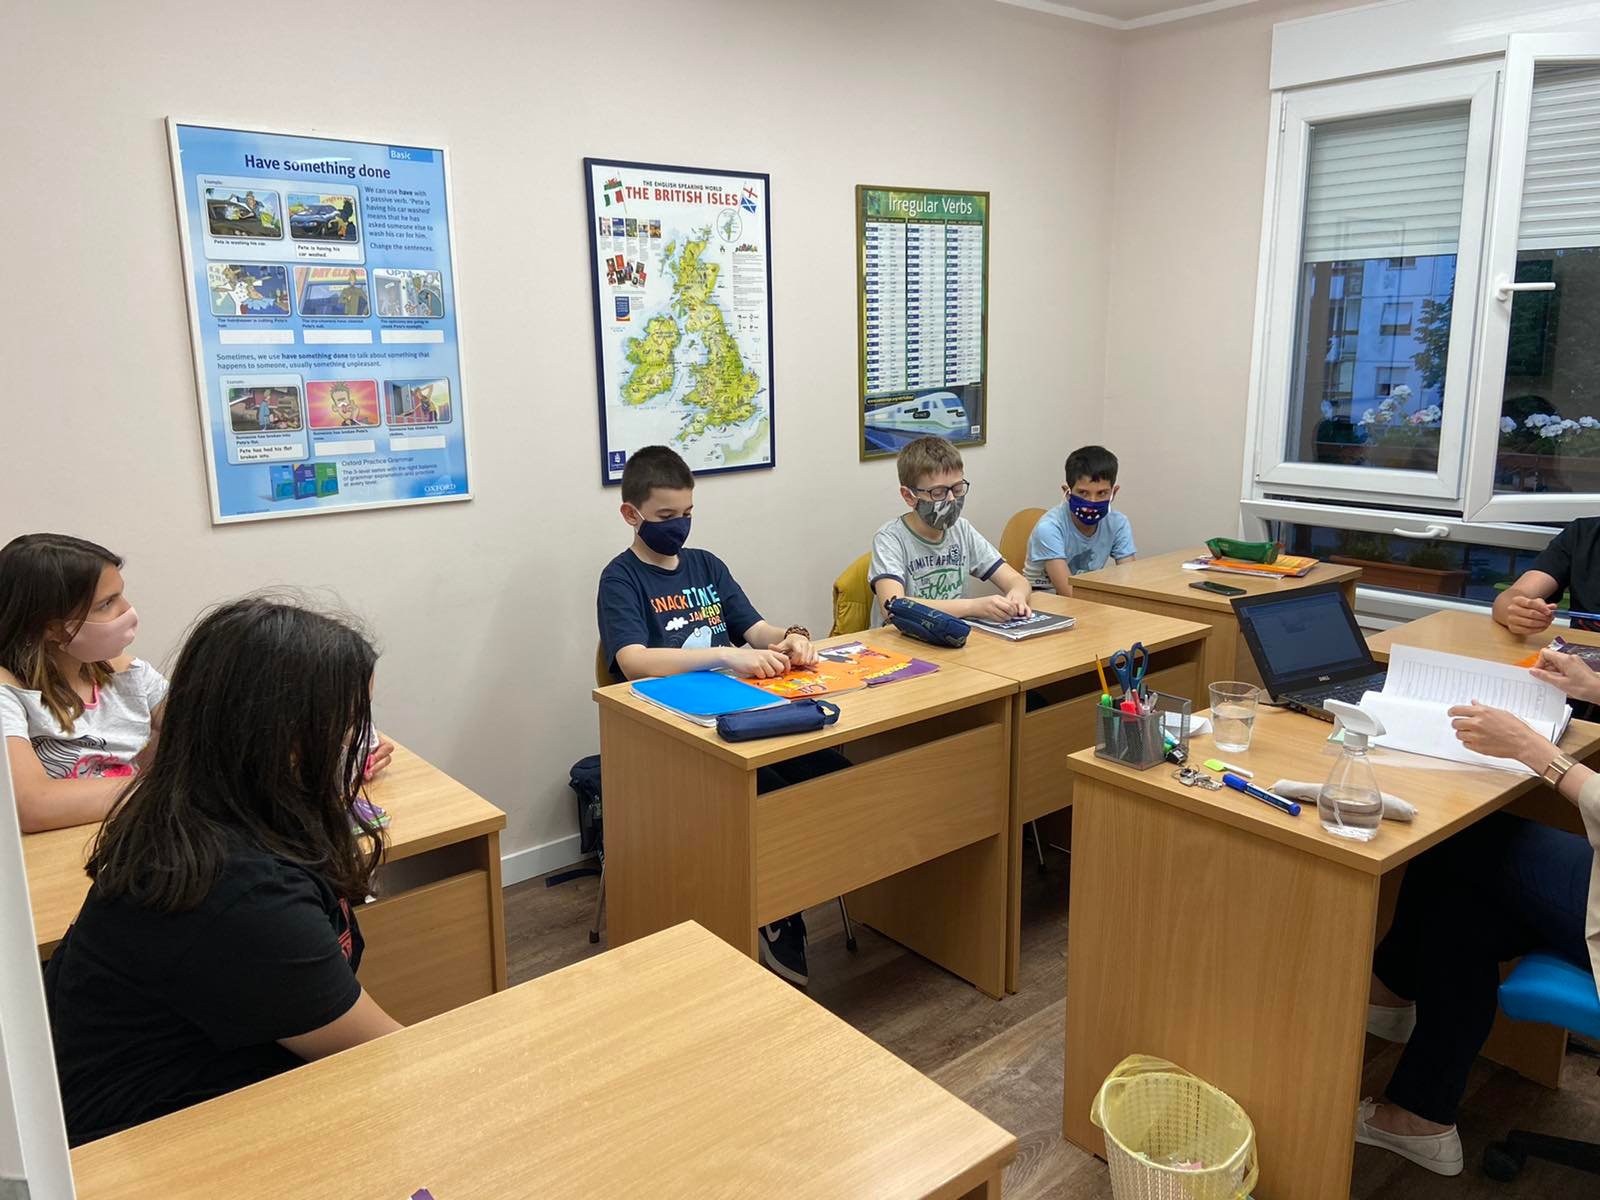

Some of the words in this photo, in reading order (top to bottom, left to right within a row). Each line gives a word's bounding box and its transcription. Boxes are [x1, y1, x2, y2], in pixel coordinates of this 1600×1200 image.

[390, 150, 411, 161] Basic
[245, 154, 280, 170] Have
[284, 160, 356, 178] something
[359, 164, 391, 179] done
[399, 188, 413, 196] have
[625, 186, 649, 200] THE
[655, 188, 702, 203] BRITISH
[707, 192, 738, 206] ISLES
[888, 193, 939, 216] Irregular
[941, 198, 973, 215] Verbs
[370, 242, 392, 251] Change
[298, 352, 332, 360] something
[424, 484, 456, 492] OXFORD
[708, 616, 721, 626] FOR
